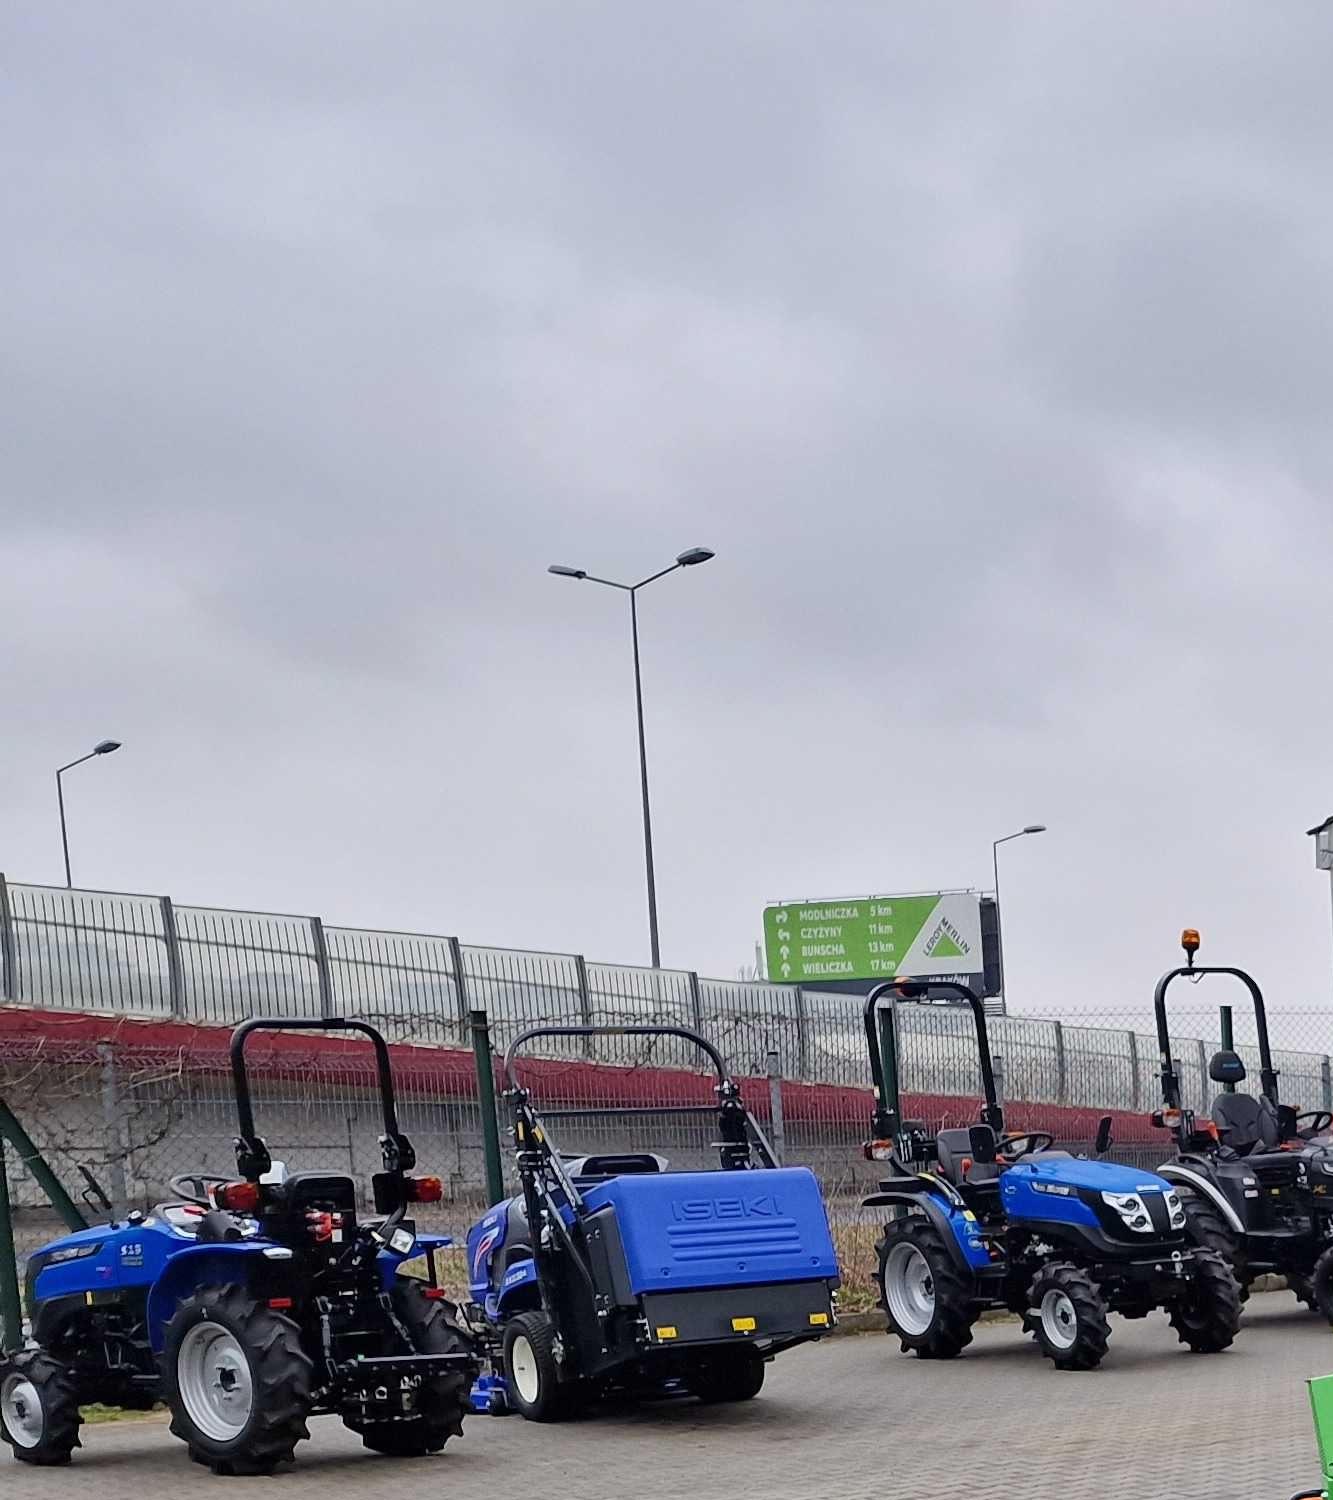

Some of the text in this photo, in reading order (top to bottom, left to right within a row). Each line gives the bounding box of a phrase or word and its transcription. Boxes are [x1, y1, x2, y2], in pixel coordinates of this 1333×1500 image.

[799, 904, 892, 921] MODLNICZKA 5 km
[868, 924, 877, 935] 11
[878, 922, 893, 935] km
[941, 917, 970, 954] MERLIN
[868, 941, 878, 953] 13
[879, 940, 895, 953] km
[923, 923, 943, 957] LEROY
[802, 959, 896, 975] WIELICZKA 17 km
[672, 1195, 784, 1222] ISEKI
